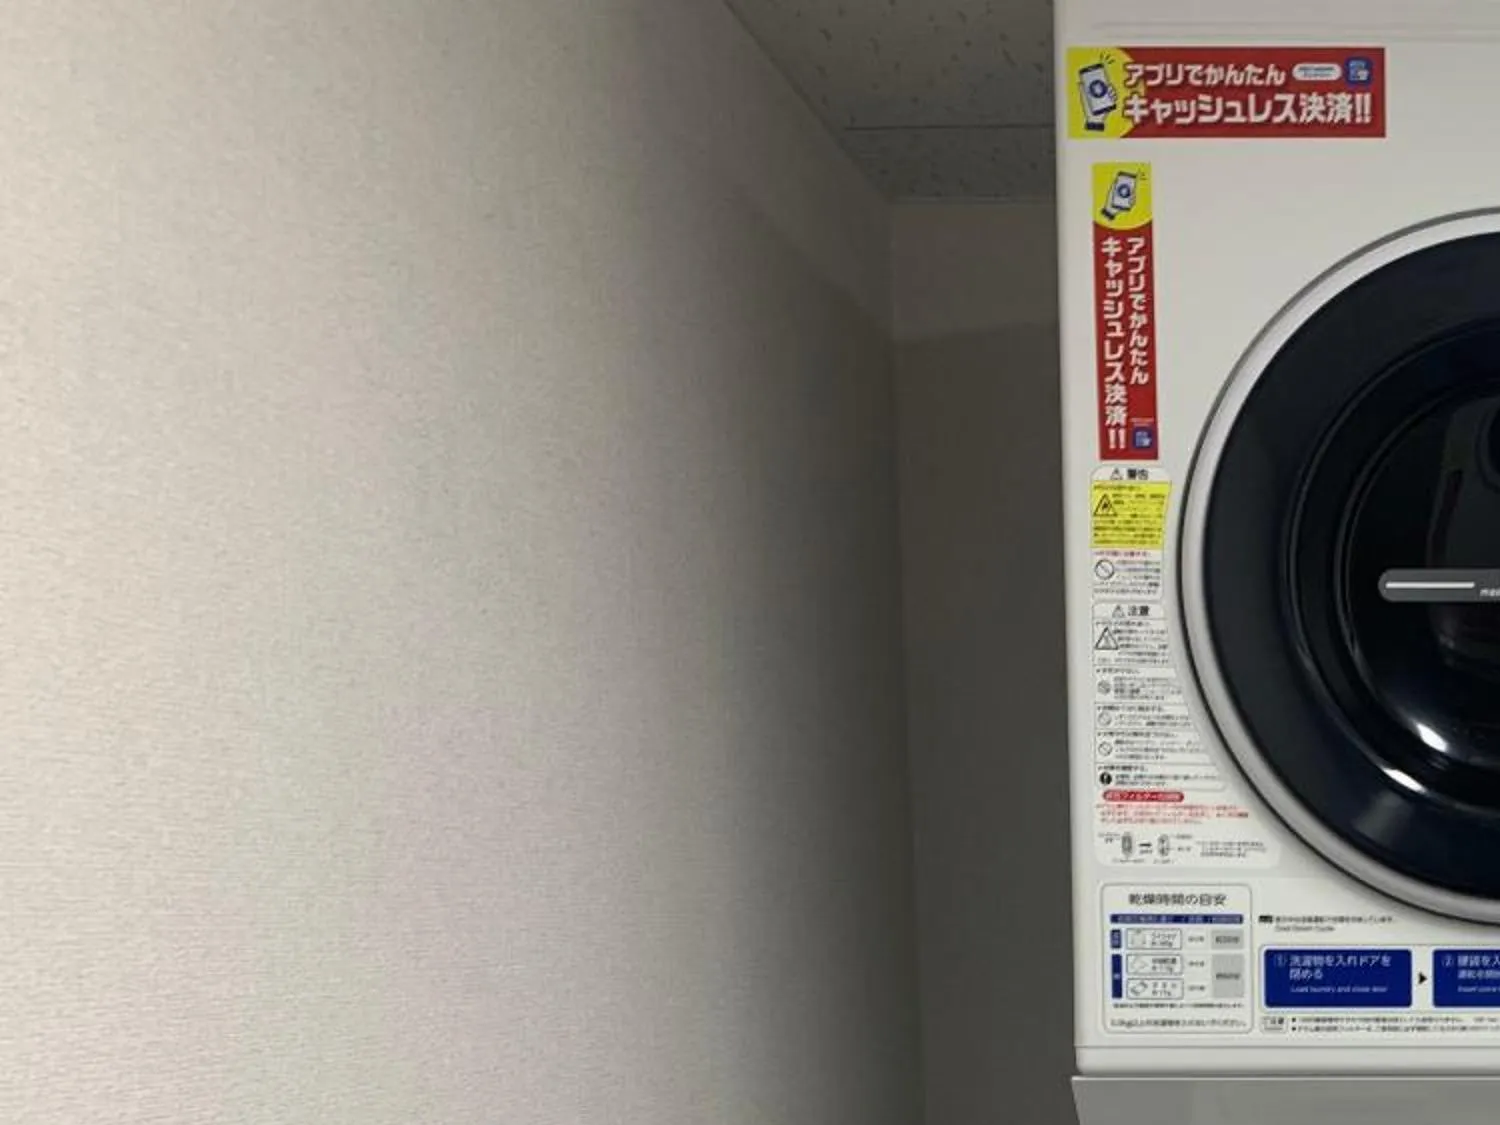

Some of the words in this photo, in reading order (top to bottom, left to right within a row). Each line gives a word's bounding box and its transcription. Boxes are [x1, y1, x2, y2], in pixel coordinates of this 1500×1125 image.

[1123, 62, 1286, 86] アプリでかんたん
[1123, 92, 1372, 125] キャッシュレス決済!!
[1101, 236, 1128, 449] キャッシュレス決済!!
[1127, 236, 1150, 385] アプリでかんたん
